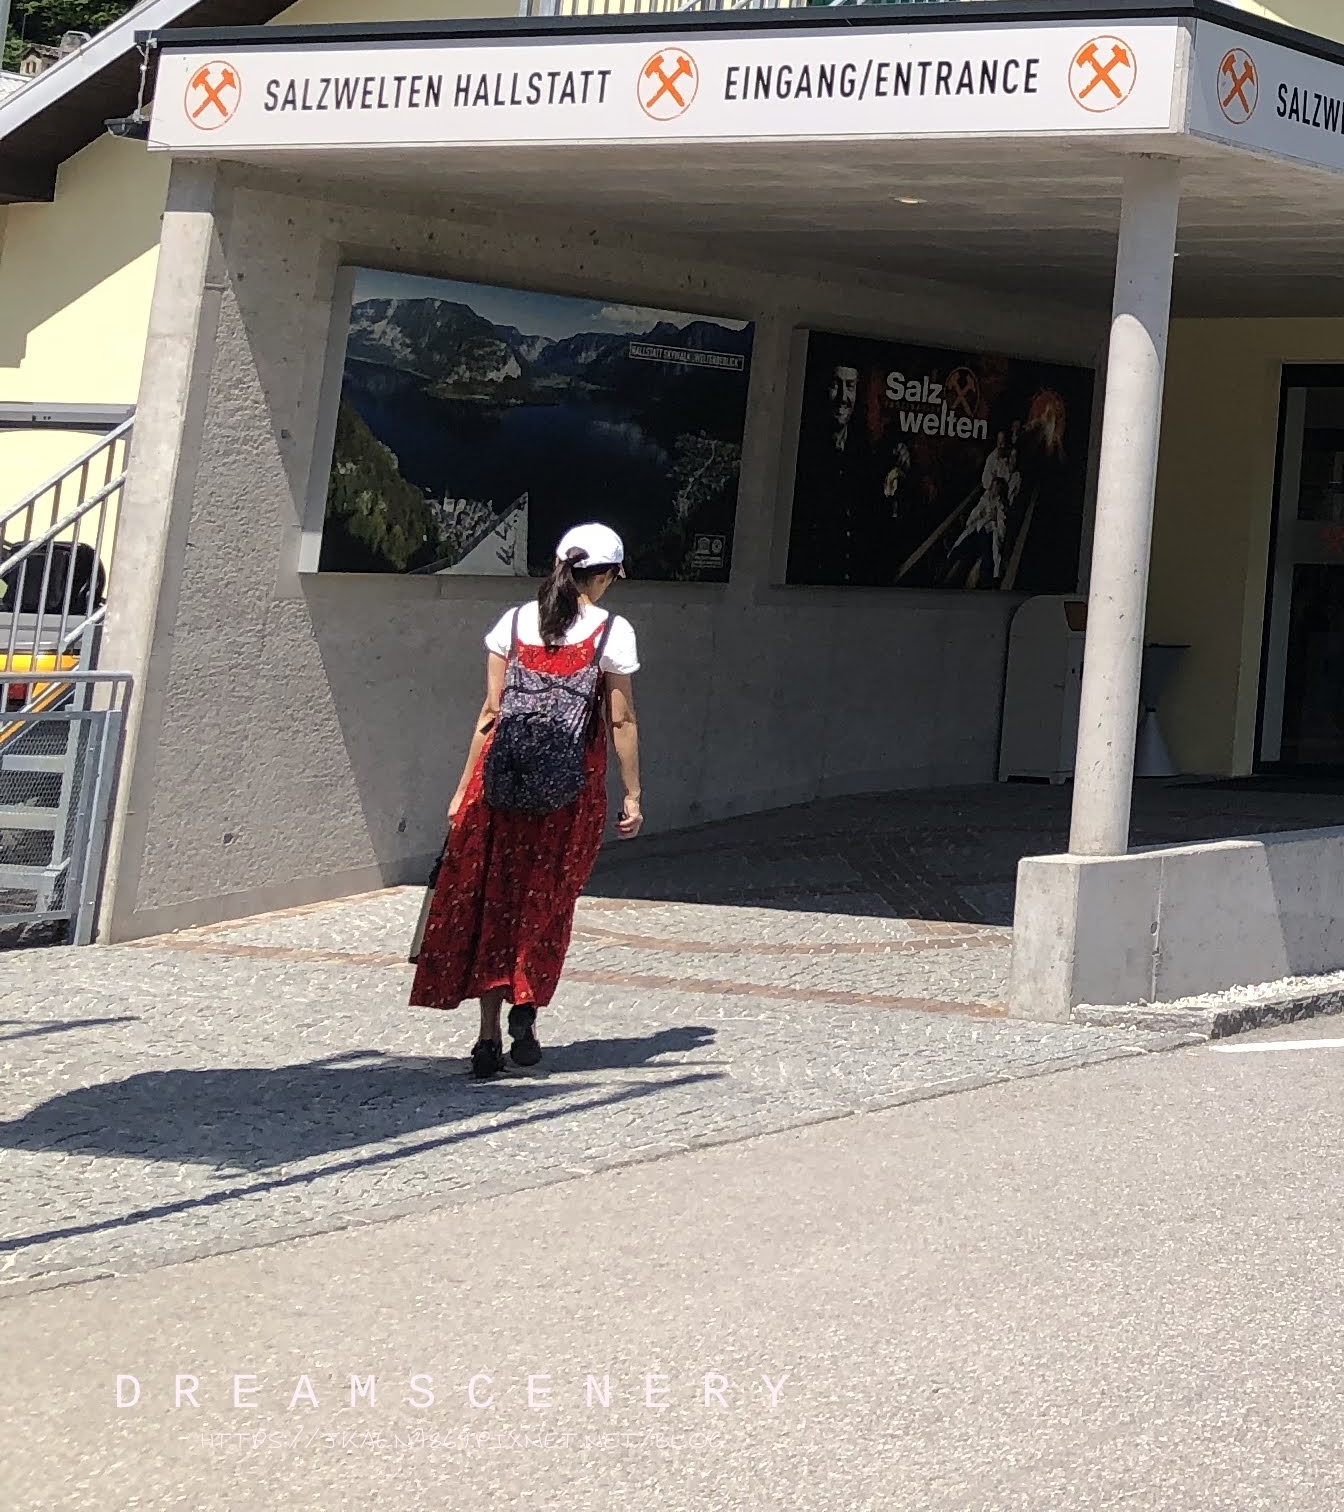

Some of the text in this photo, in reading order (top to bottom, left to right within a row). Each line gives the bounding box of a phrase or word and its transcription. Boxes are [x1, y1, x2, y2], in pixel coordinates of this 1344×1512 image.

[264, 70, 611, 112] SALZWELTEN HALLSTATT
[724, 58, 1040, 101] EINGANG/ENTRANCE
[885, 371, 943, 404] Salz
[899, 400, 988, 440] welten
